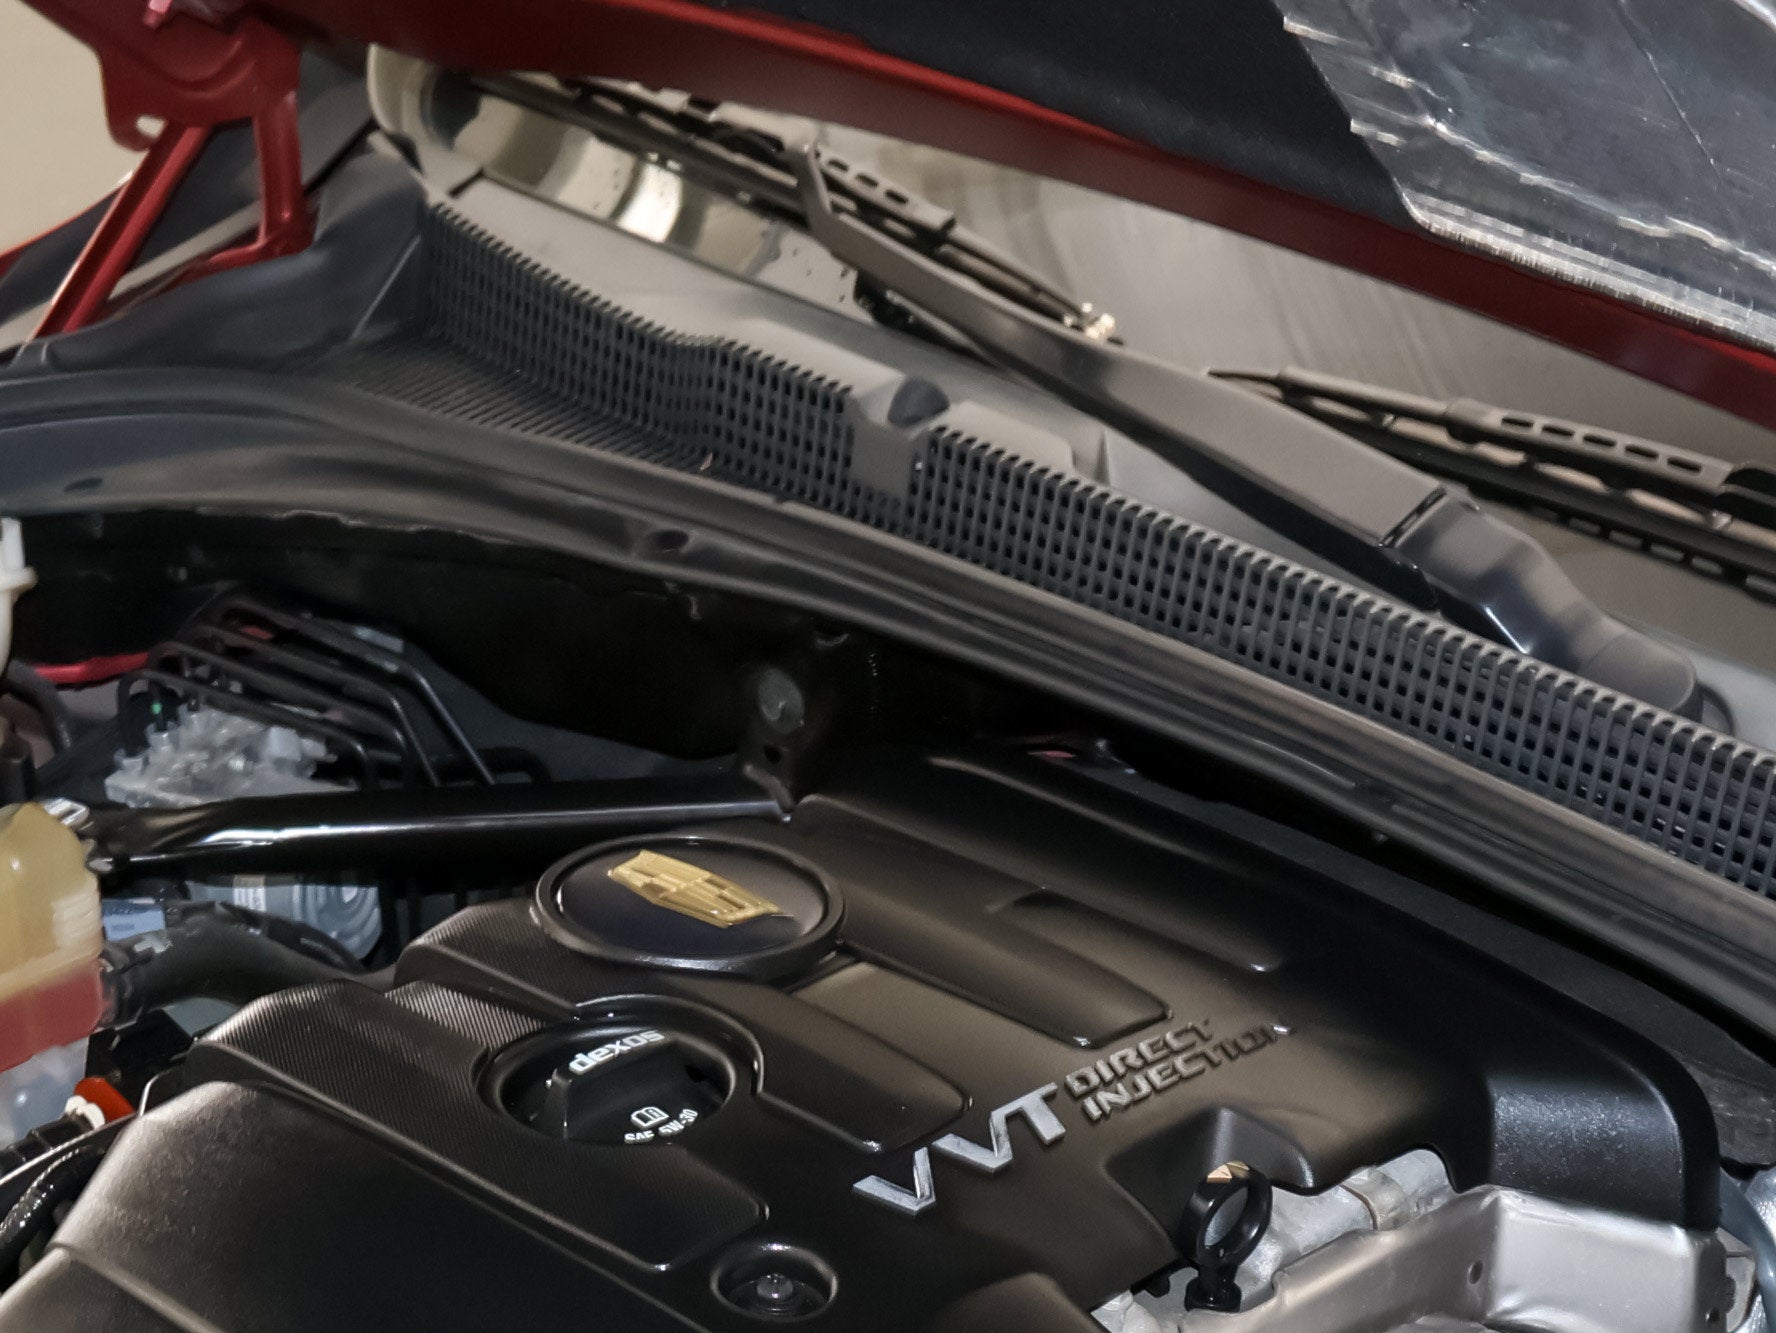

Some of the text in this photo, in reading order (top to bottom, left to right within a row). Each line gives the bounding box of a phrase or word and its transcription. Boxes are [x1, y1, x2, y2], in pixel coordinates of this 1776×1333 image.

[569, 1030, 665, 1075] dexos
[1064, 1019, 1213, 1098] DIRECT
[658, 1108, 699, 1137] 5W-30
[852, 1082, 1067, 1217] VVT
